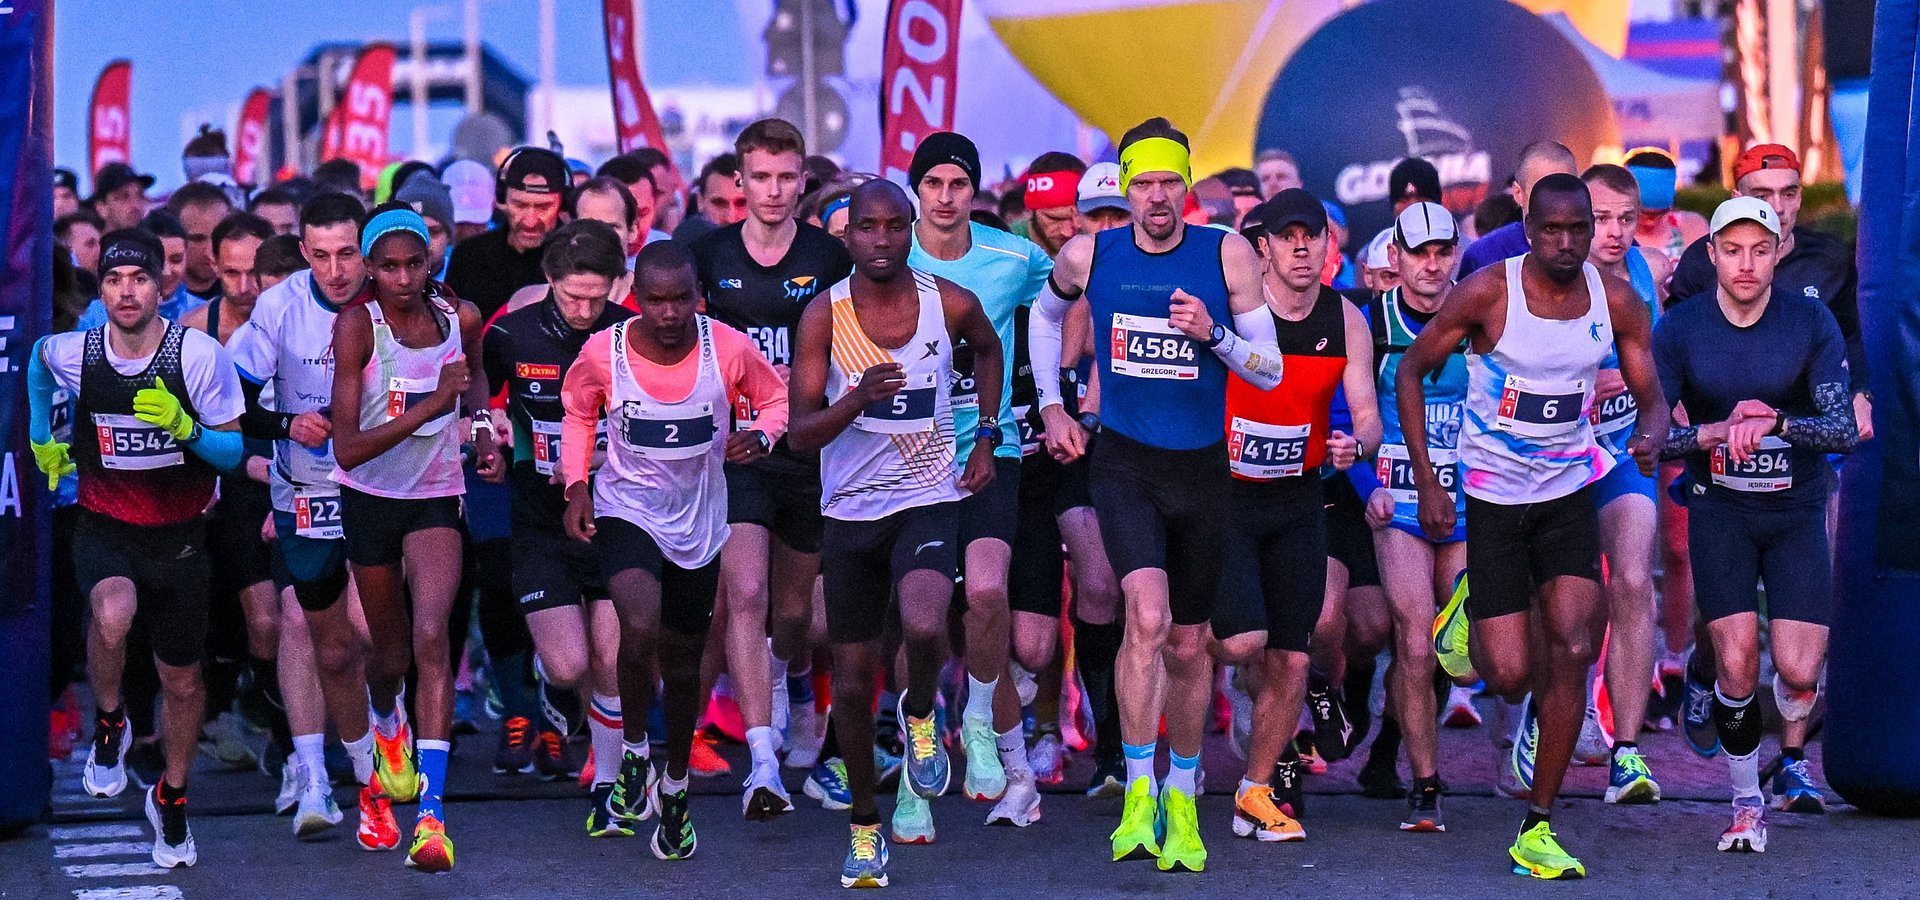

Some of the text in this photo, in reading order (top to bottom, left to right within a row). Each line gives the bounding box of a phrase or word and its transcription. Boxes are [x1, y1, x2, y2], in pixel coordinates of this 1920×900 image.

[1116, 330, 1124, 340] A
[1117, 346, 1123, 356] 1
[1129, 336, 1195, 361] 4584
[1141, 367, 1177, 376] GRZEGORZ
[394, 393, 402, 402] A
[1506, 391, 1516, 401] A
[892, 394, 908, 414] 5
[394, 406, 399, 414] 1
[1505, 405, 1511, 414] 1
[1542, 400, 1559, 419] 6
[102, 428, 110, 438] B
[664, 424, 679, 443] 2
[1233, 433, 1242, 443] A
[115, 430, 177, 451] 5542
[538, 435, 545, 444] A
[105, 442, 111, 452] 3
[1244, 440, 1304, 461] 4155
[1714, 447, 1722, 457] A
[1232, 448, 1238, 457] 1
[1381, 460, 1389, 470] A
[1715, 462, 1721, 472] 1
[1380, 475, 1387, 485] 1
[1394, 464, 1454, 487] 16
[299, 499, 307, 509] A
[311, 501, 341, 521] 22
[301, 515, 307, 525] 1
